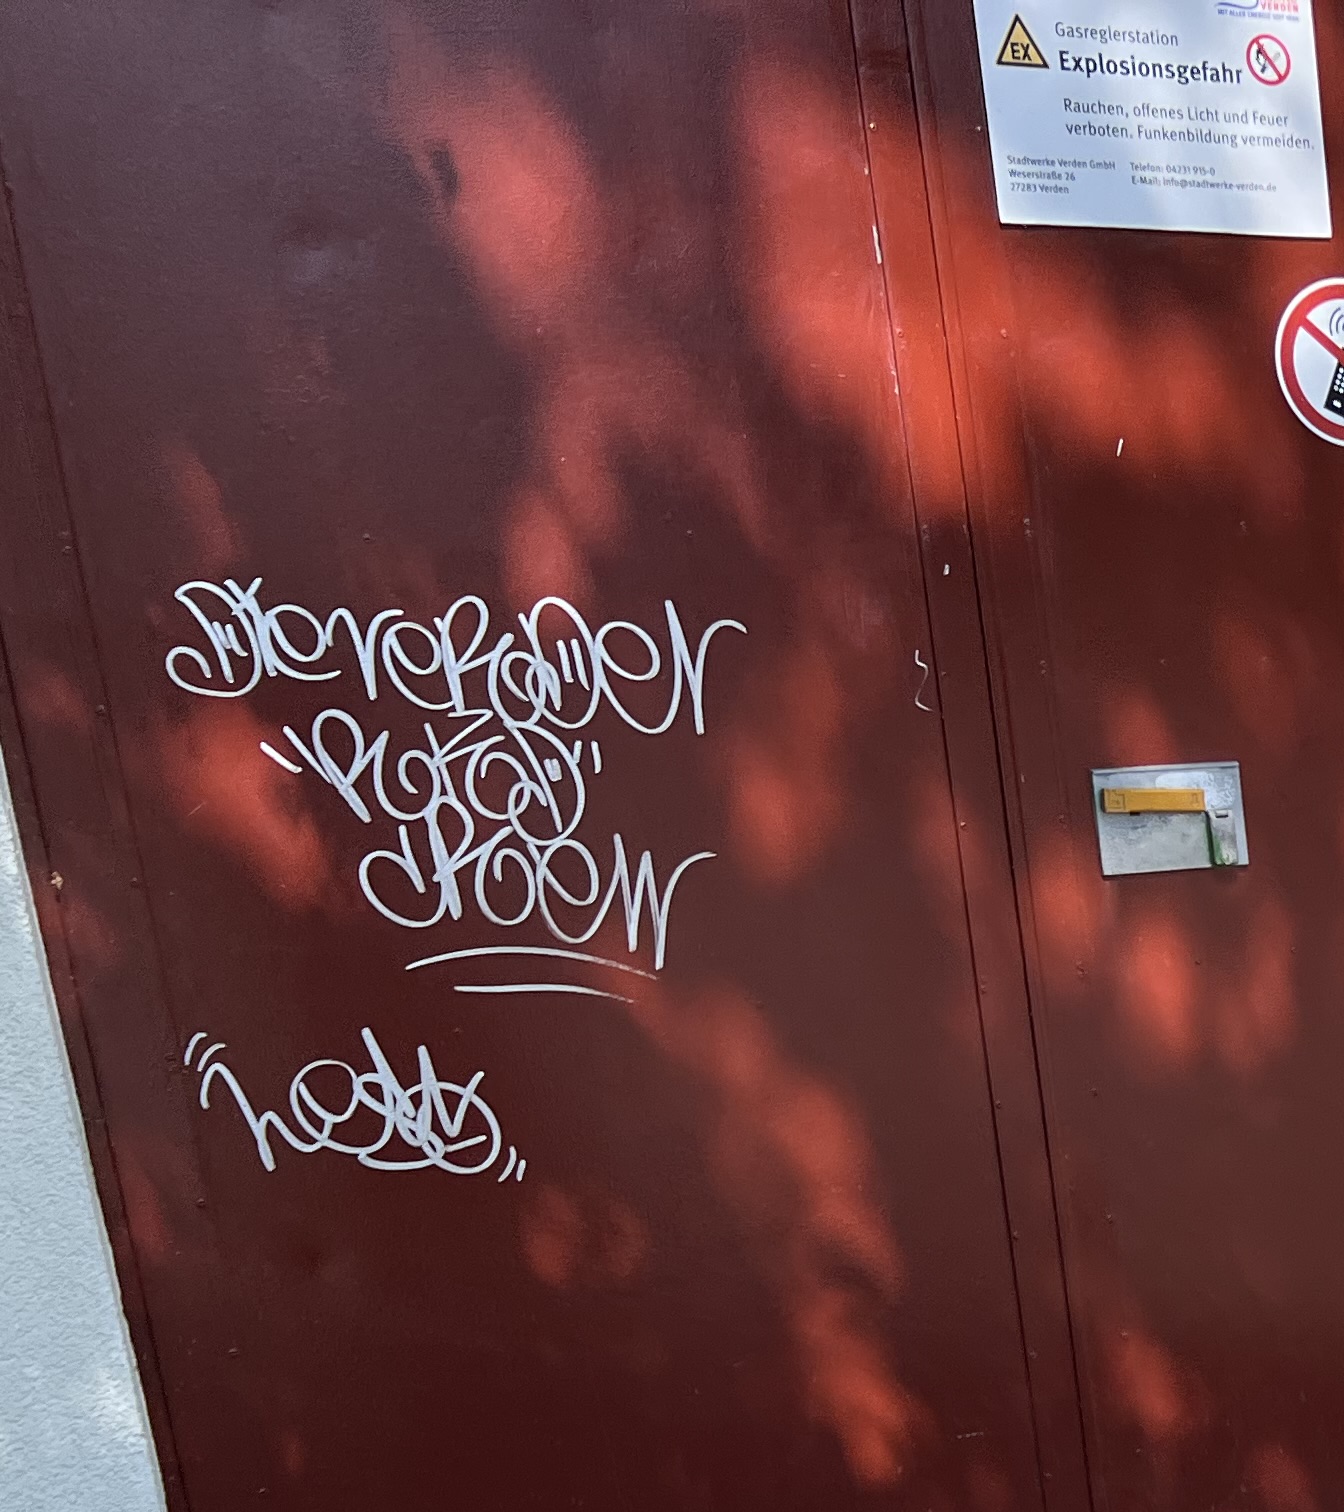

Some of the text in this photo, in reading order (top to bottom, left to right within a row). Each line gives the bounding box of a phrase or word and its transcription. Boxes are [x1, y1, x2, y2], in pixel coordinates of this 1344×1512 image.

[1054, 21, 1179, 46] Gasreglerstation
[1010, 42, 1032, 62] EX
[1058, 50, 1243, 86] Explosionsgefahr
[1063, 97, 1289, 127] Rauchen, offenes Licht und Feuer
[1065, 121, 1315, 150] verboten. Funkenbildung vermeiden.
[1007, 155, 1116, 170] Stadtwerke Verden GmbH
[1129, 161, 1163, 173] Telefon:
[1008, 169, 1076, 182] Weserstraße 26
[1010, 182, 1069, 195] 27283 Verden
